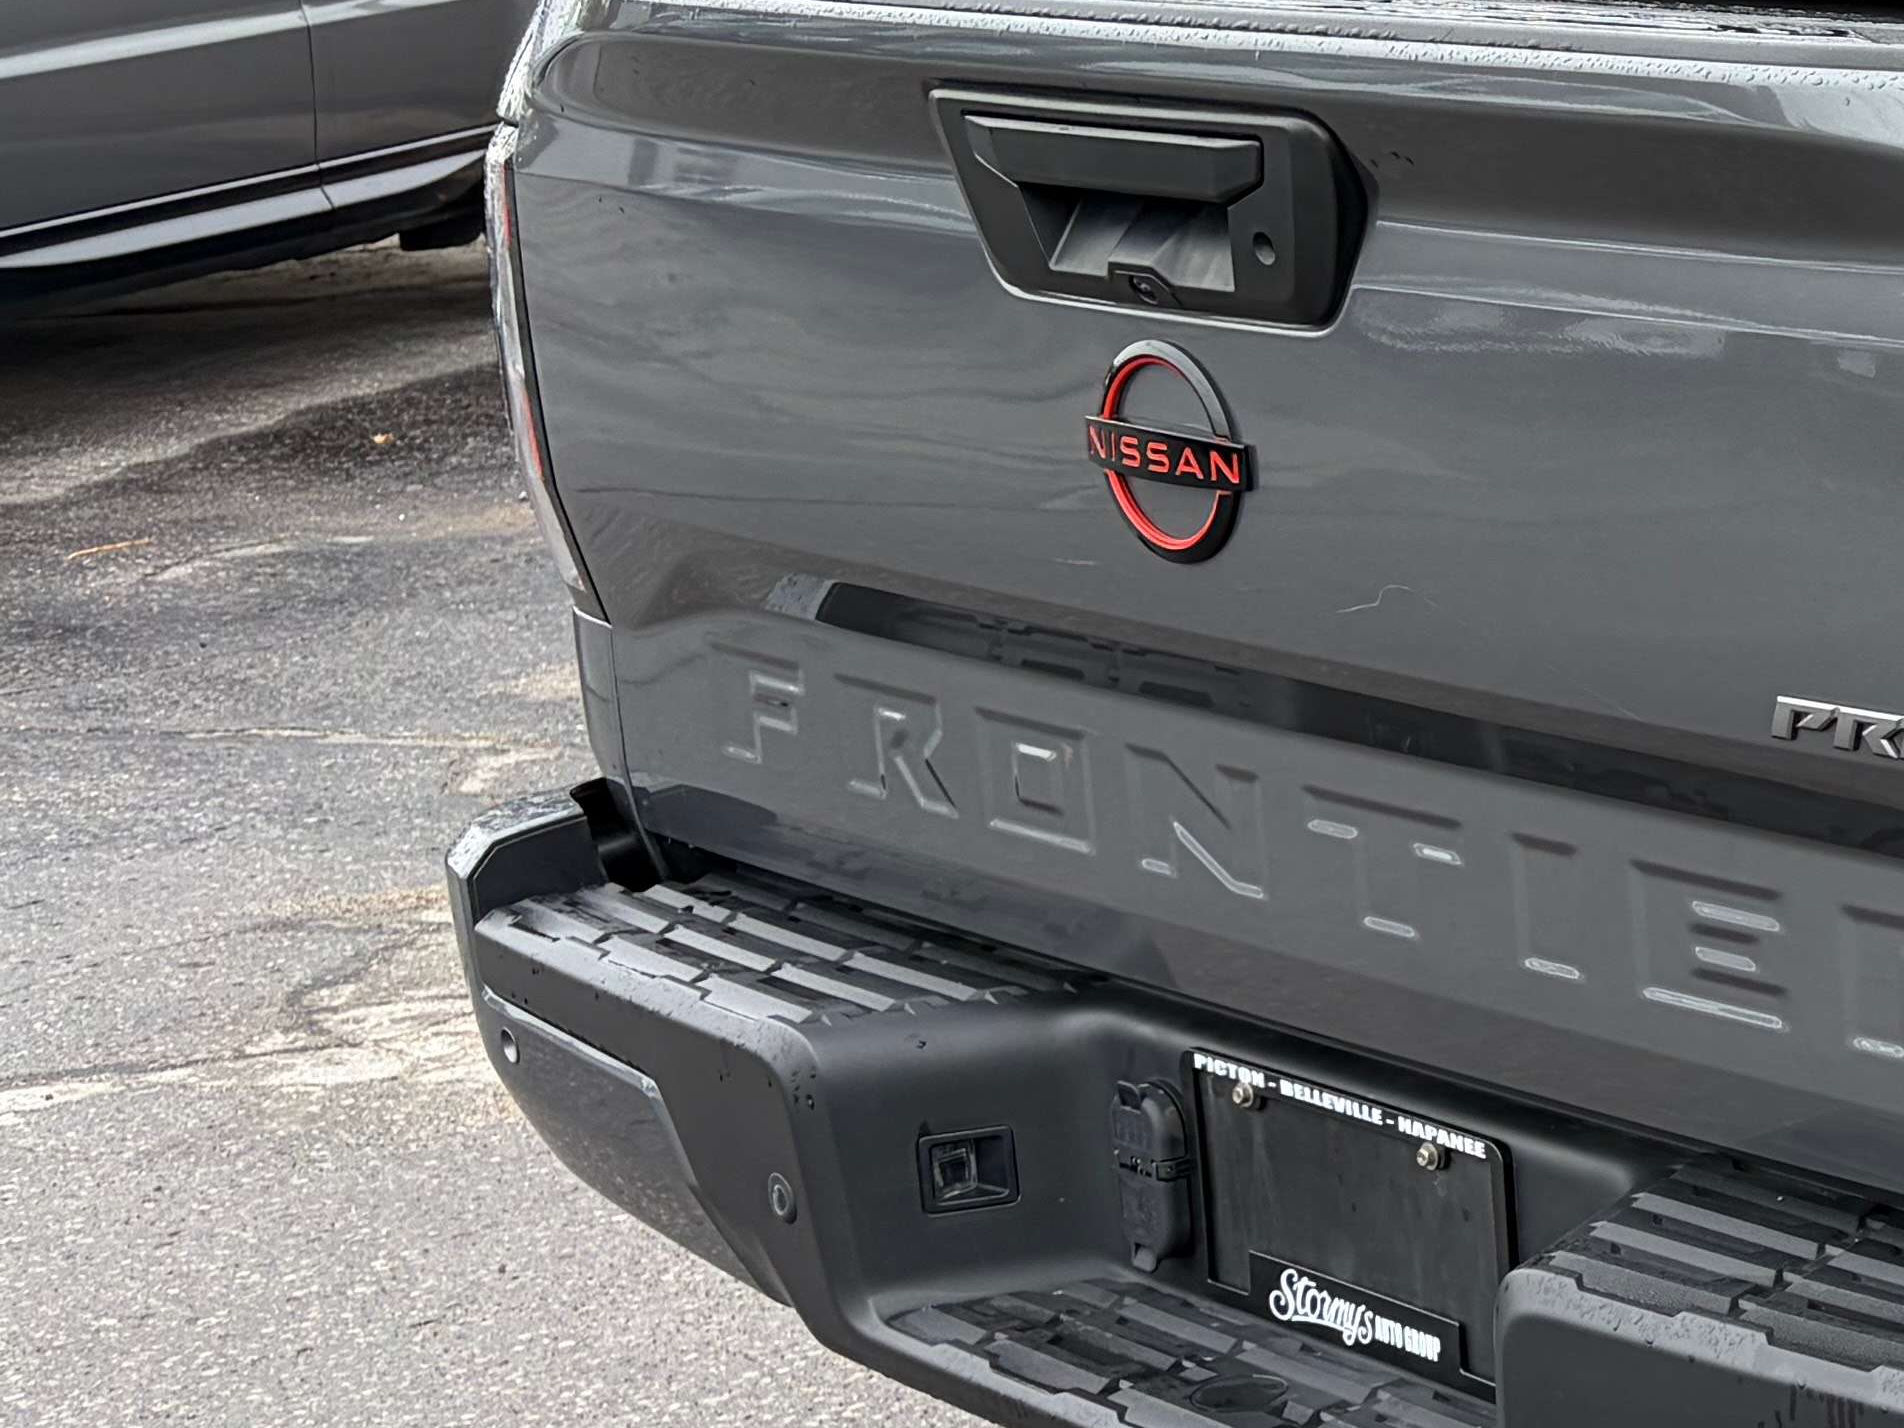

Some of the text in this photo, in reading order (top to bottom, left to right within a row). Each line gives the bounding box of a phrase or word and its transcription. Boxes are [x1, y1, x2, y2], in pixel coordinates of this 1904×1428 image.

[1088, 426, 1241, 485] NISSAN
[1193, 1052, 1266, 1089] PICTON
[1279, 1078, 1384, 1126] BELLEVILLE
[1397, 1115, 1487, 1160] NAPANEE
[1374, 1315, 1403, 1349] AUTO
[1403, 1325, 1441, 1363] GROUP
